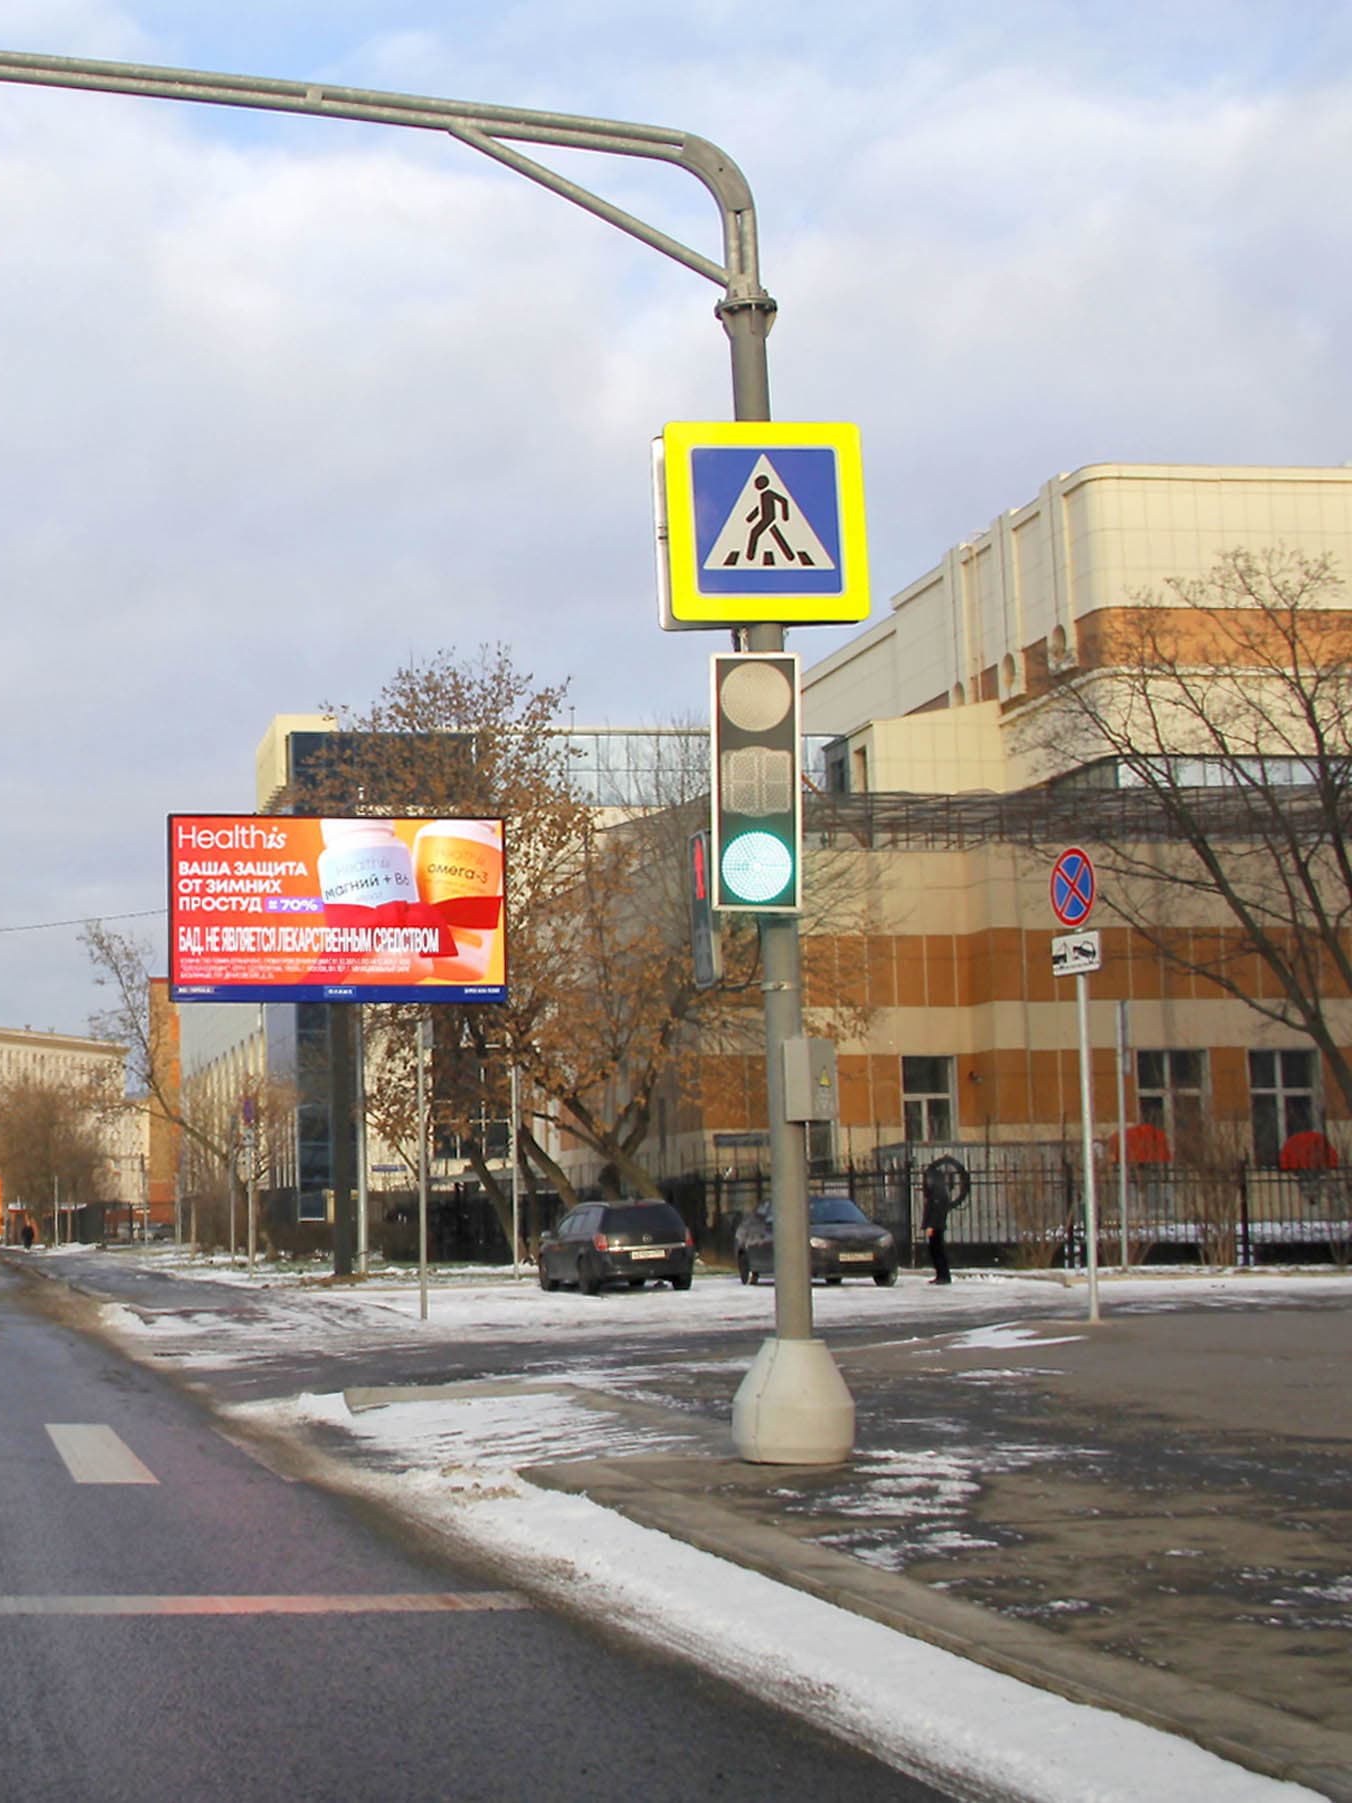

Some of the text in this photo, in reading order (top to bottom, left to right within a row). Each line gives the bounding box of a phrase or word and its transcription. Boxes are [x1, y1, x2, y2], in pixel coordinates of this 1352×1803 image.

[178, 861, 308, 877] ВАША ЗАЩИТА
[427, 863, 489, 884] омега-3
[178, 878, 282, 893] ОТ ЗИМНИХ
[325, 873, 380, 900] магний
[178, 896, 263, 912] ПРОСТУД
[279, 899, 319, 911] 70%
[205, 926, 220, 953] НЕ
[221, 926, 276, 953] ЯВЛЯЕТСЯ
[277, 926, 372, 953] ЛЕКАРСТВЕННЫМ
[373, 927, 440, 953] СРЕДСТВОМ
